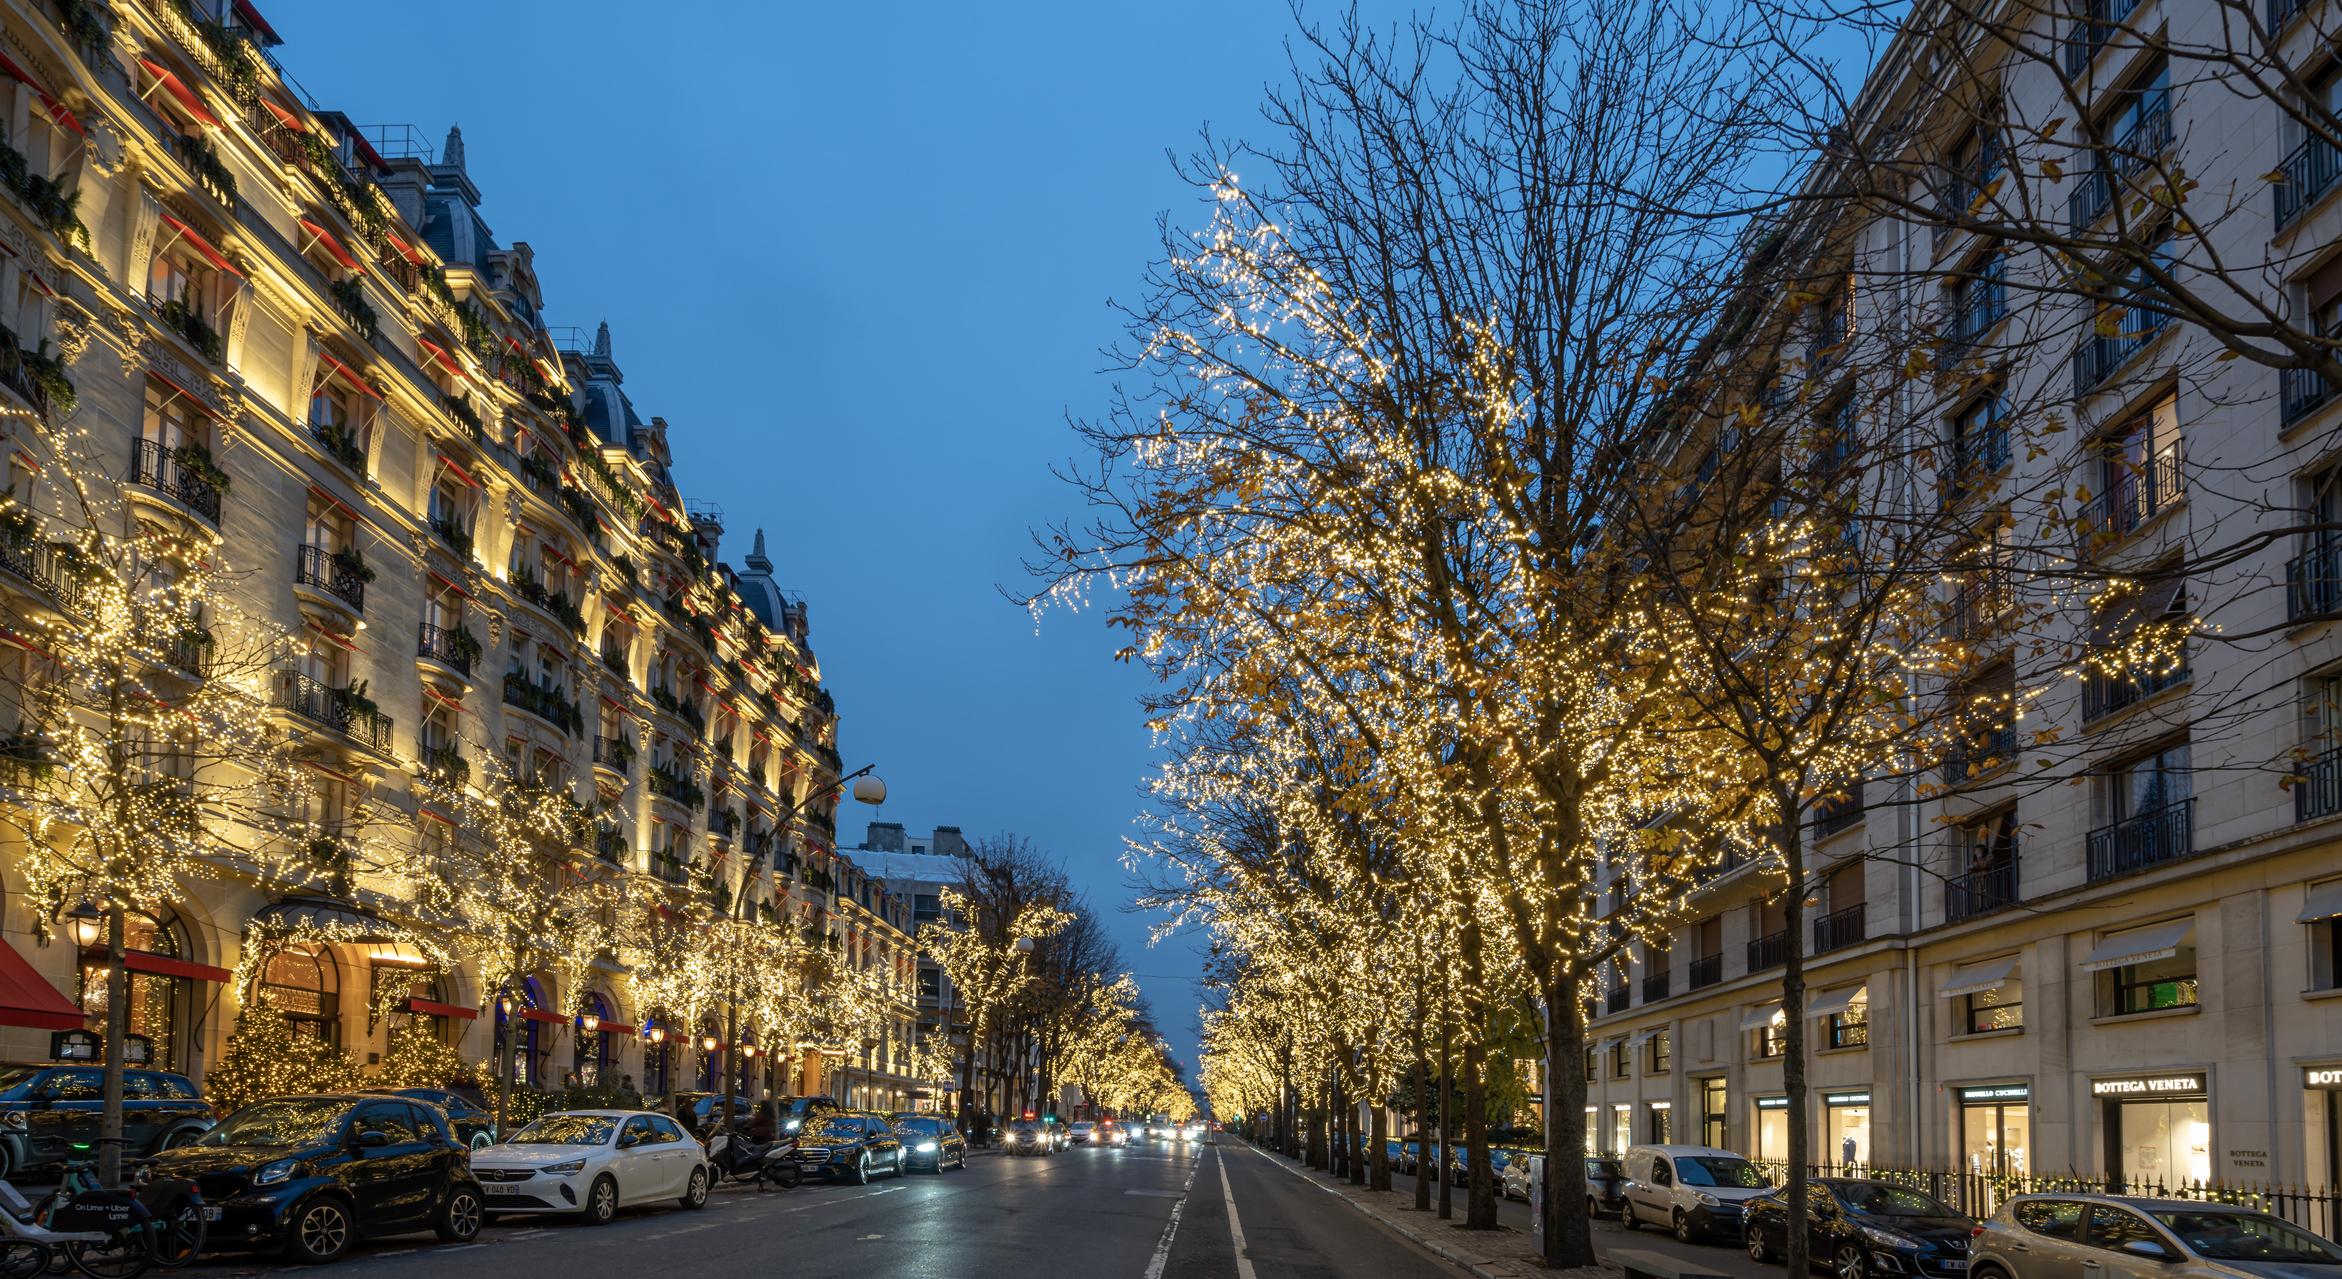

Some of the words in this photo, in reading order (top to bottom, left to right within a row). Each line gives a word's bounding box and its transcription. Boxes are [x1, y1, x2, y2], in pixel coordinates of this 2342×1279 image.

[2095, 957, 2129, 969] BOTTEGA
[2132, 950, 2163, 961] VENETA
[2094, 1081, 2146, 1093] BOTTEGA
[2148, 1079, 2198, 1091] VENETA
[2230, 1150, 2268, 1158] BOTTEGA
[2233, 1160, 2266, 1168] VENETA
[111, 1204, 130, 1212] Uber
